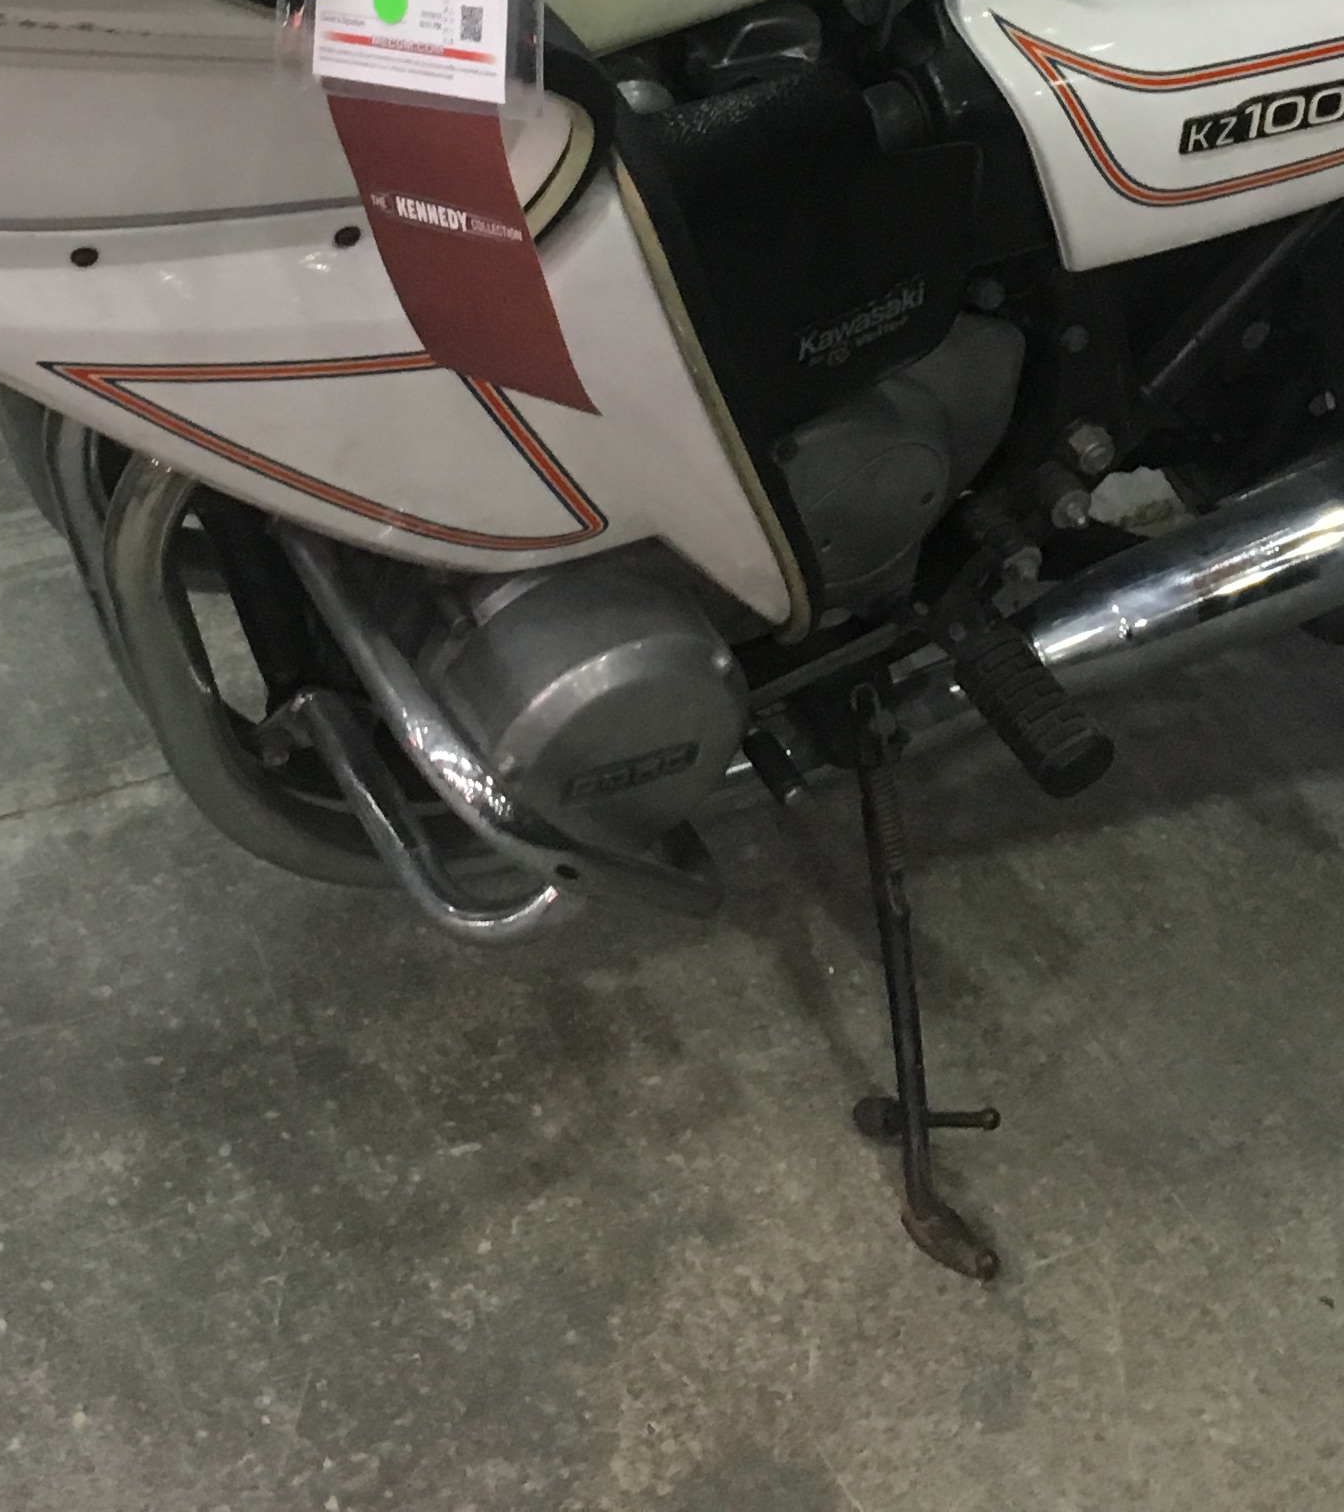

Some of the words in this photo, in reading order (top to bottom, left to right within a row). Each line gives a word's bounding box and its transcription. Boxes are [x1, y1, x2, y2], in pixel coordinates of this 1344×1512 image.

[395, 196, 467, 232] KENNEDY
[470, 218, 523, 241] COLLECTION
[798, 282, 926, 362] Kawasaki
